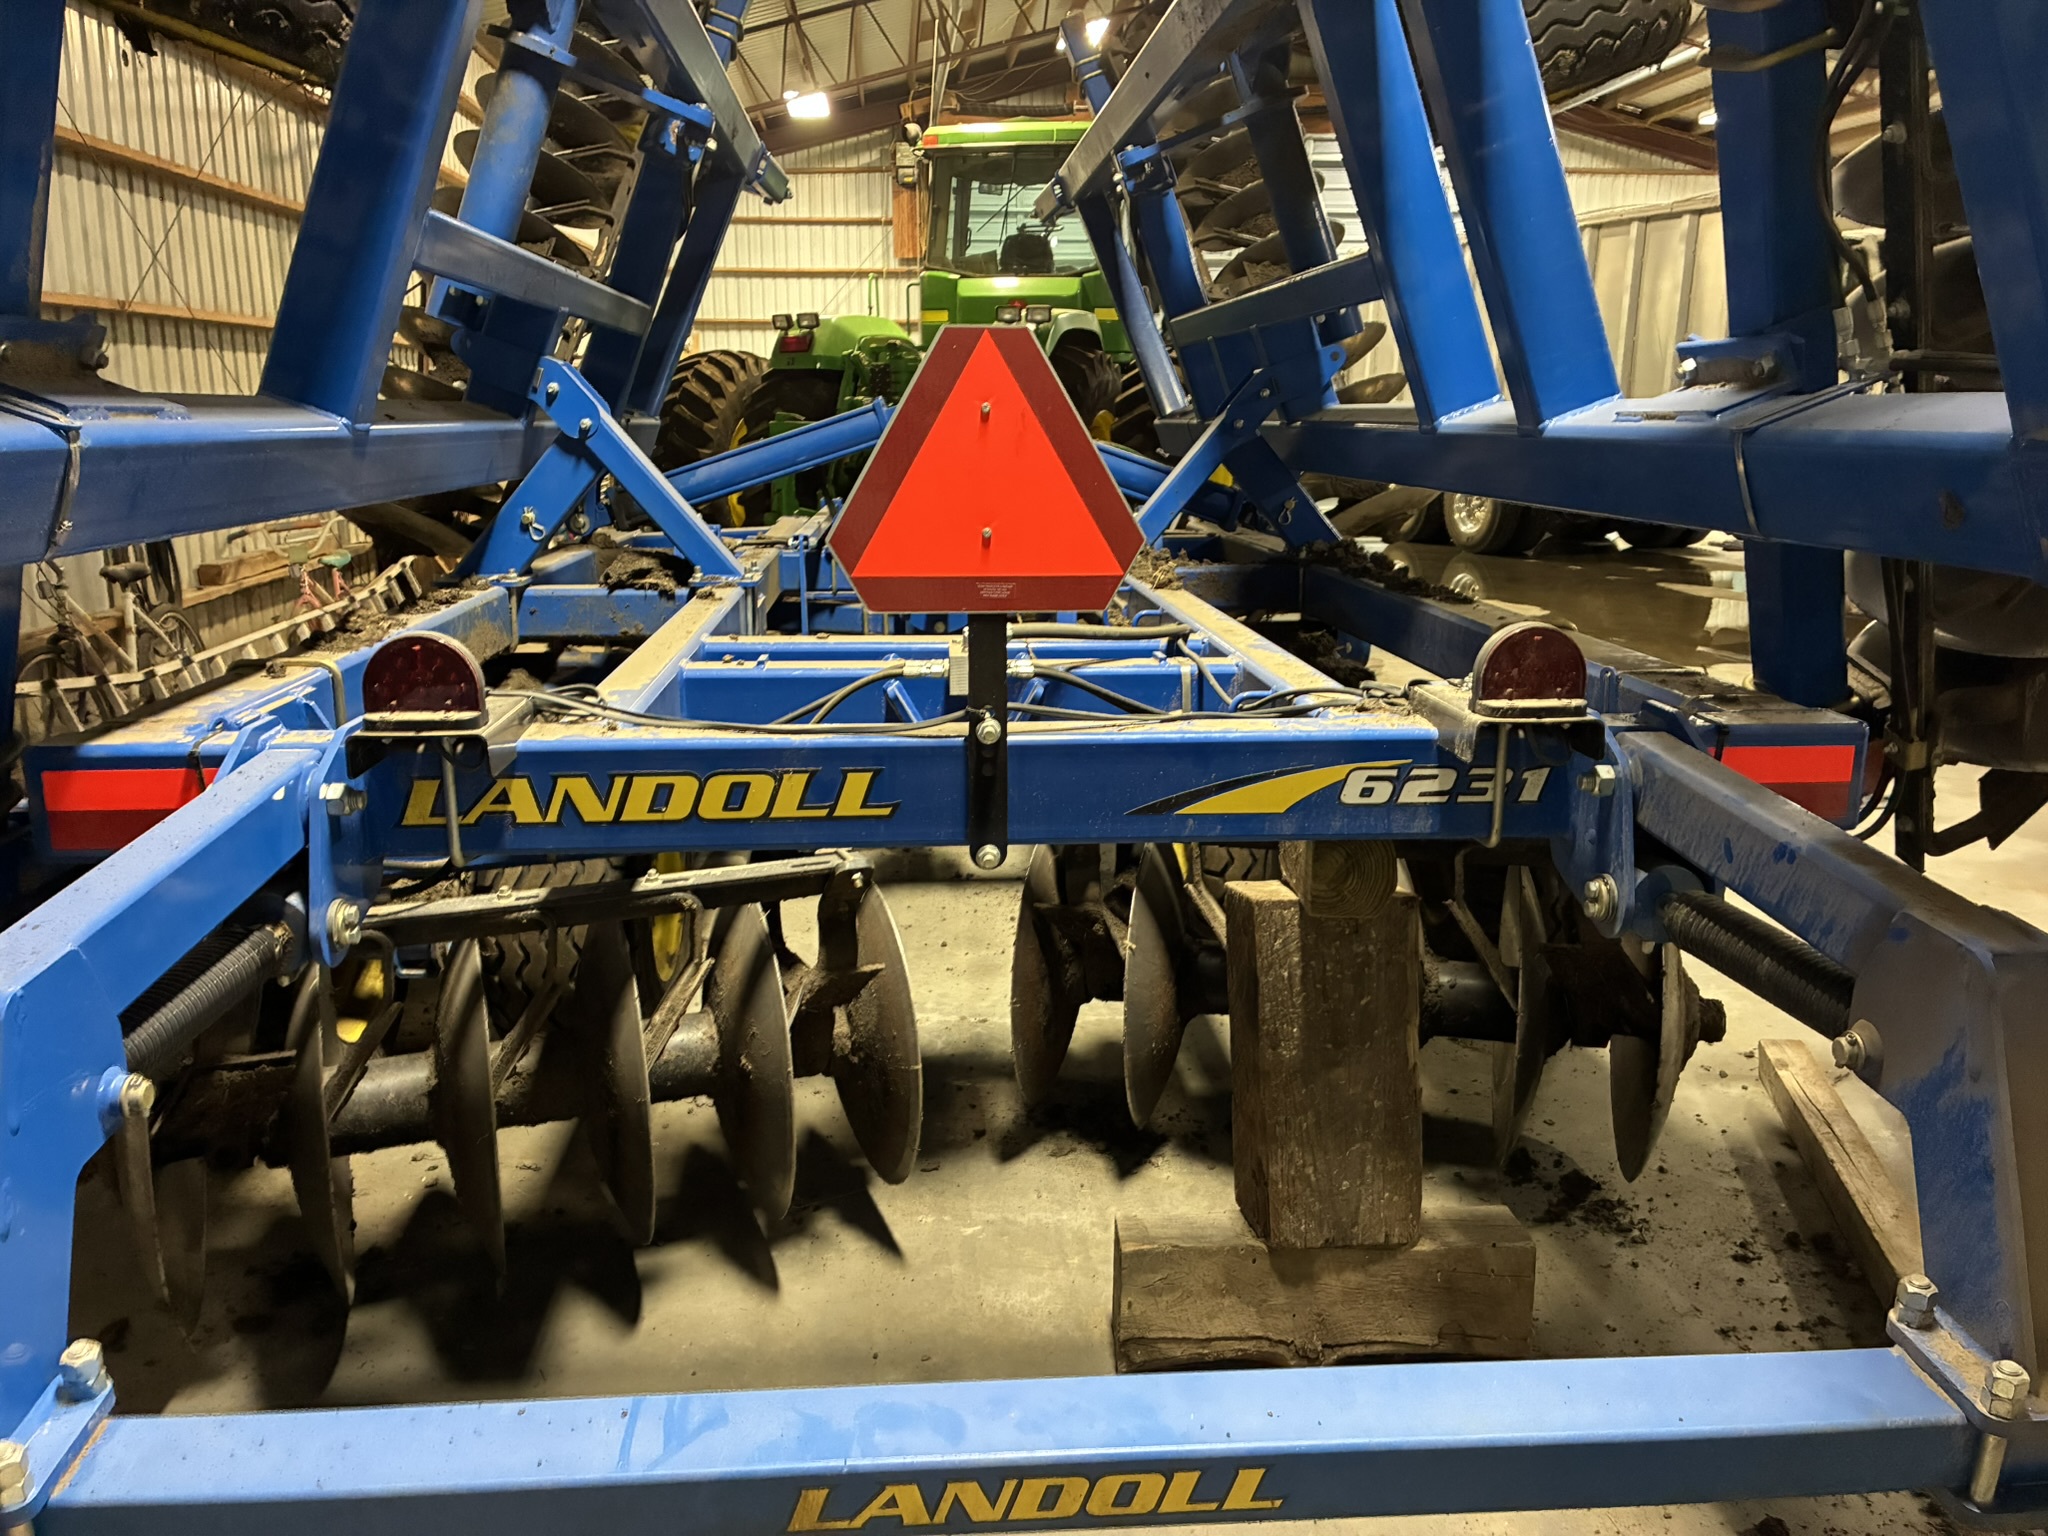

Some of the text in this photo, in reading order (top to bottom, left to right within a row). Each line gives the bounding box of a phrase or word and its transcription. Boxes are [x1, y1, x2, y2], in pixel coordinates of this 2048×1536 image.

[400, 769, 898, 826] LANDOLL
[1338, 766, 1552, 805] 6231
[787, 1467, 1284, 1533] LANDOLL
